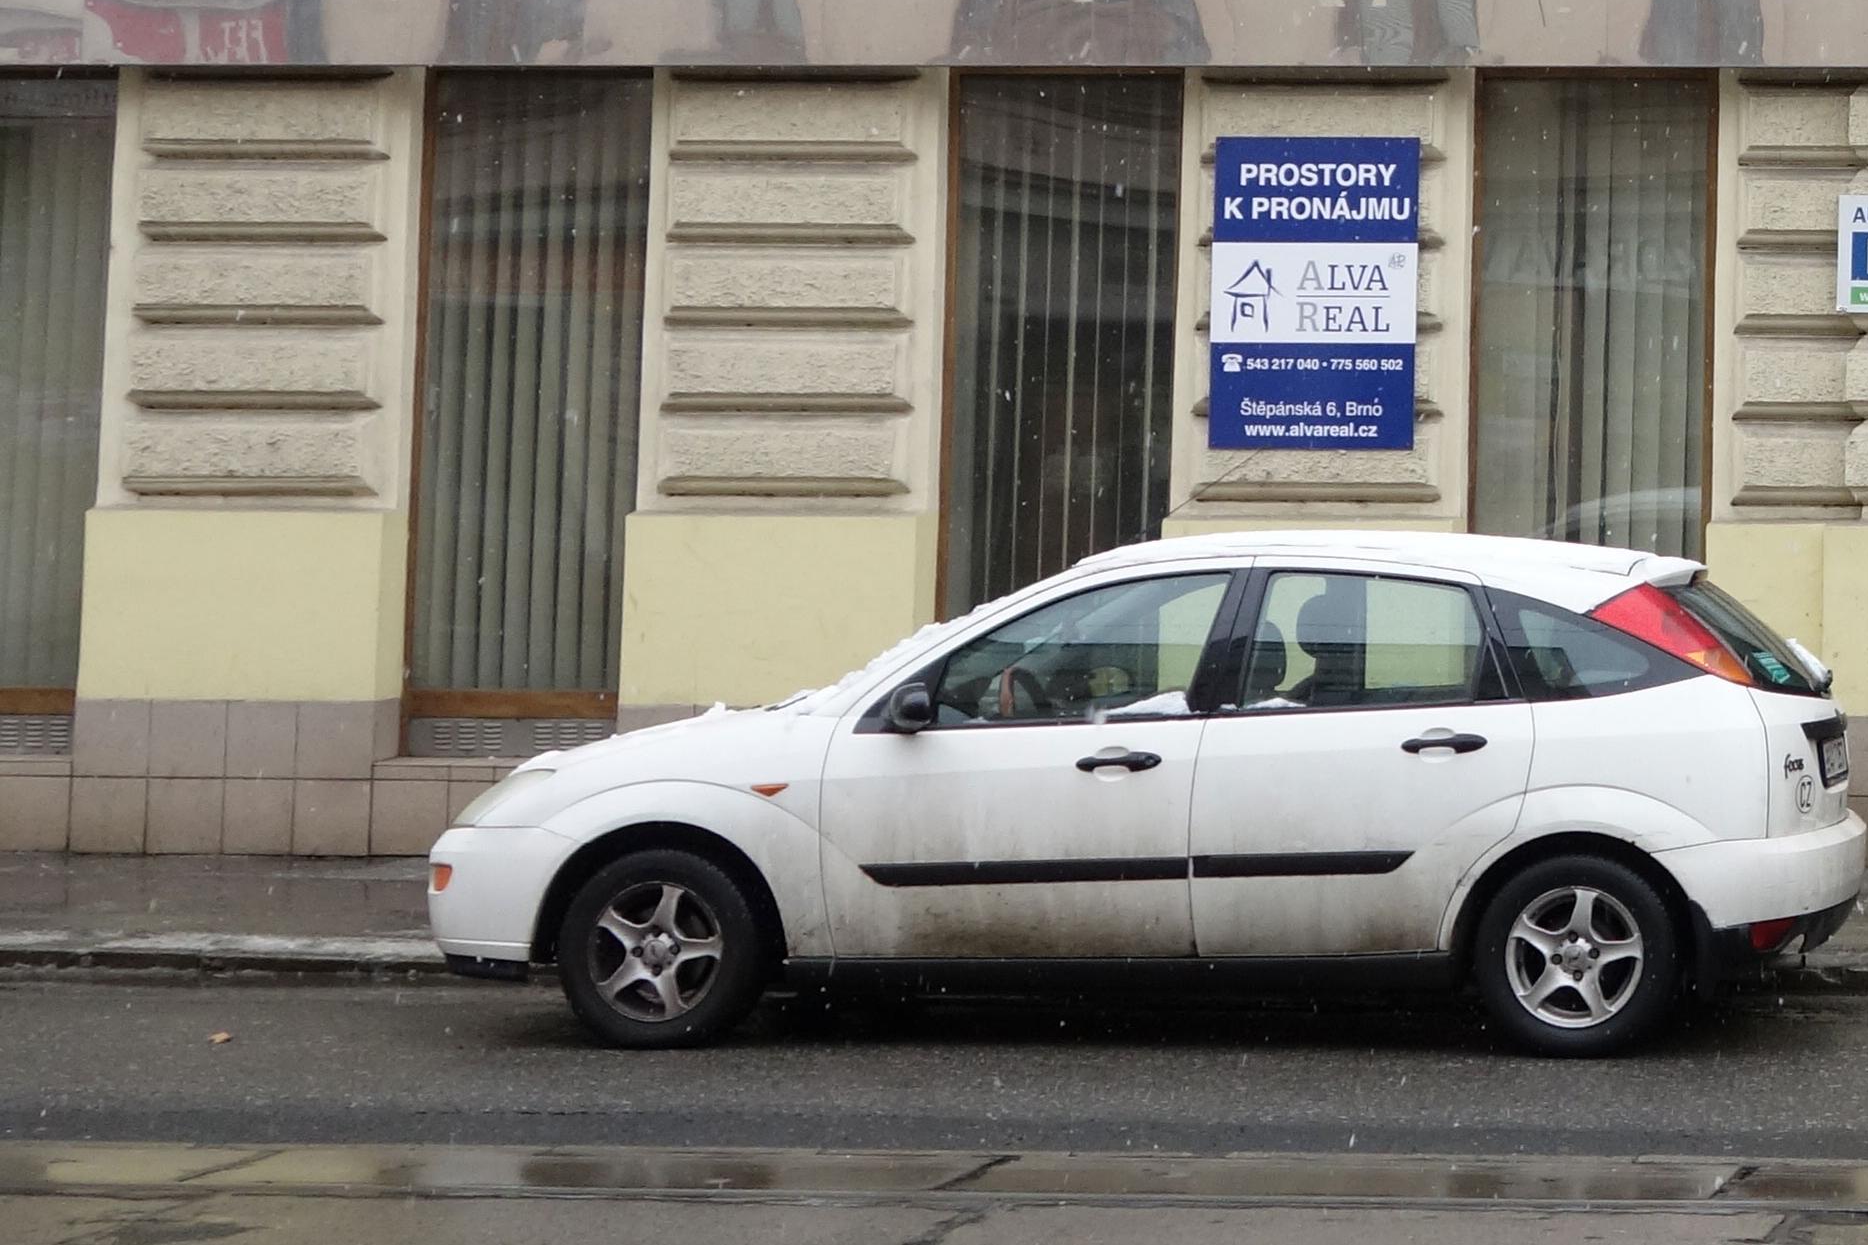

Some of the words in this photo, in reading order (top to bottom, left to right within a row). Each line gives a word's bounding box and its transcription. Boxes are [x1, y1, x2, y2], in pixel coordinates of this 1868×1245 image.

[1239, 163, 1397, 186] PROSTORY
[1224, 198, 1243, 219] K
[1252, 191, 1411, 221] PRONÁJMU
[1298, 260, 1389, 291] ALVA
[1296, 302, 1390, 333] REAL
[1246, 359, 1268, 370] 543
[1272, 359, 1293, 370] 217
[1297, 359, 1319, 370] 040
[1330, 359, 1352, 370] 775
[1355, 359, 1377, 370] 560
[1380, 359, 1403, 370] 502
[1240, 397, 1322, 419] Štěpánská
[1326, 402, 1341, 417] 6,
[1346, 401, 1383, 416] Brno
[1245, 423, 1378, 437] www.alvareal.cz
[1800, 781, 1811, 808] CZ
